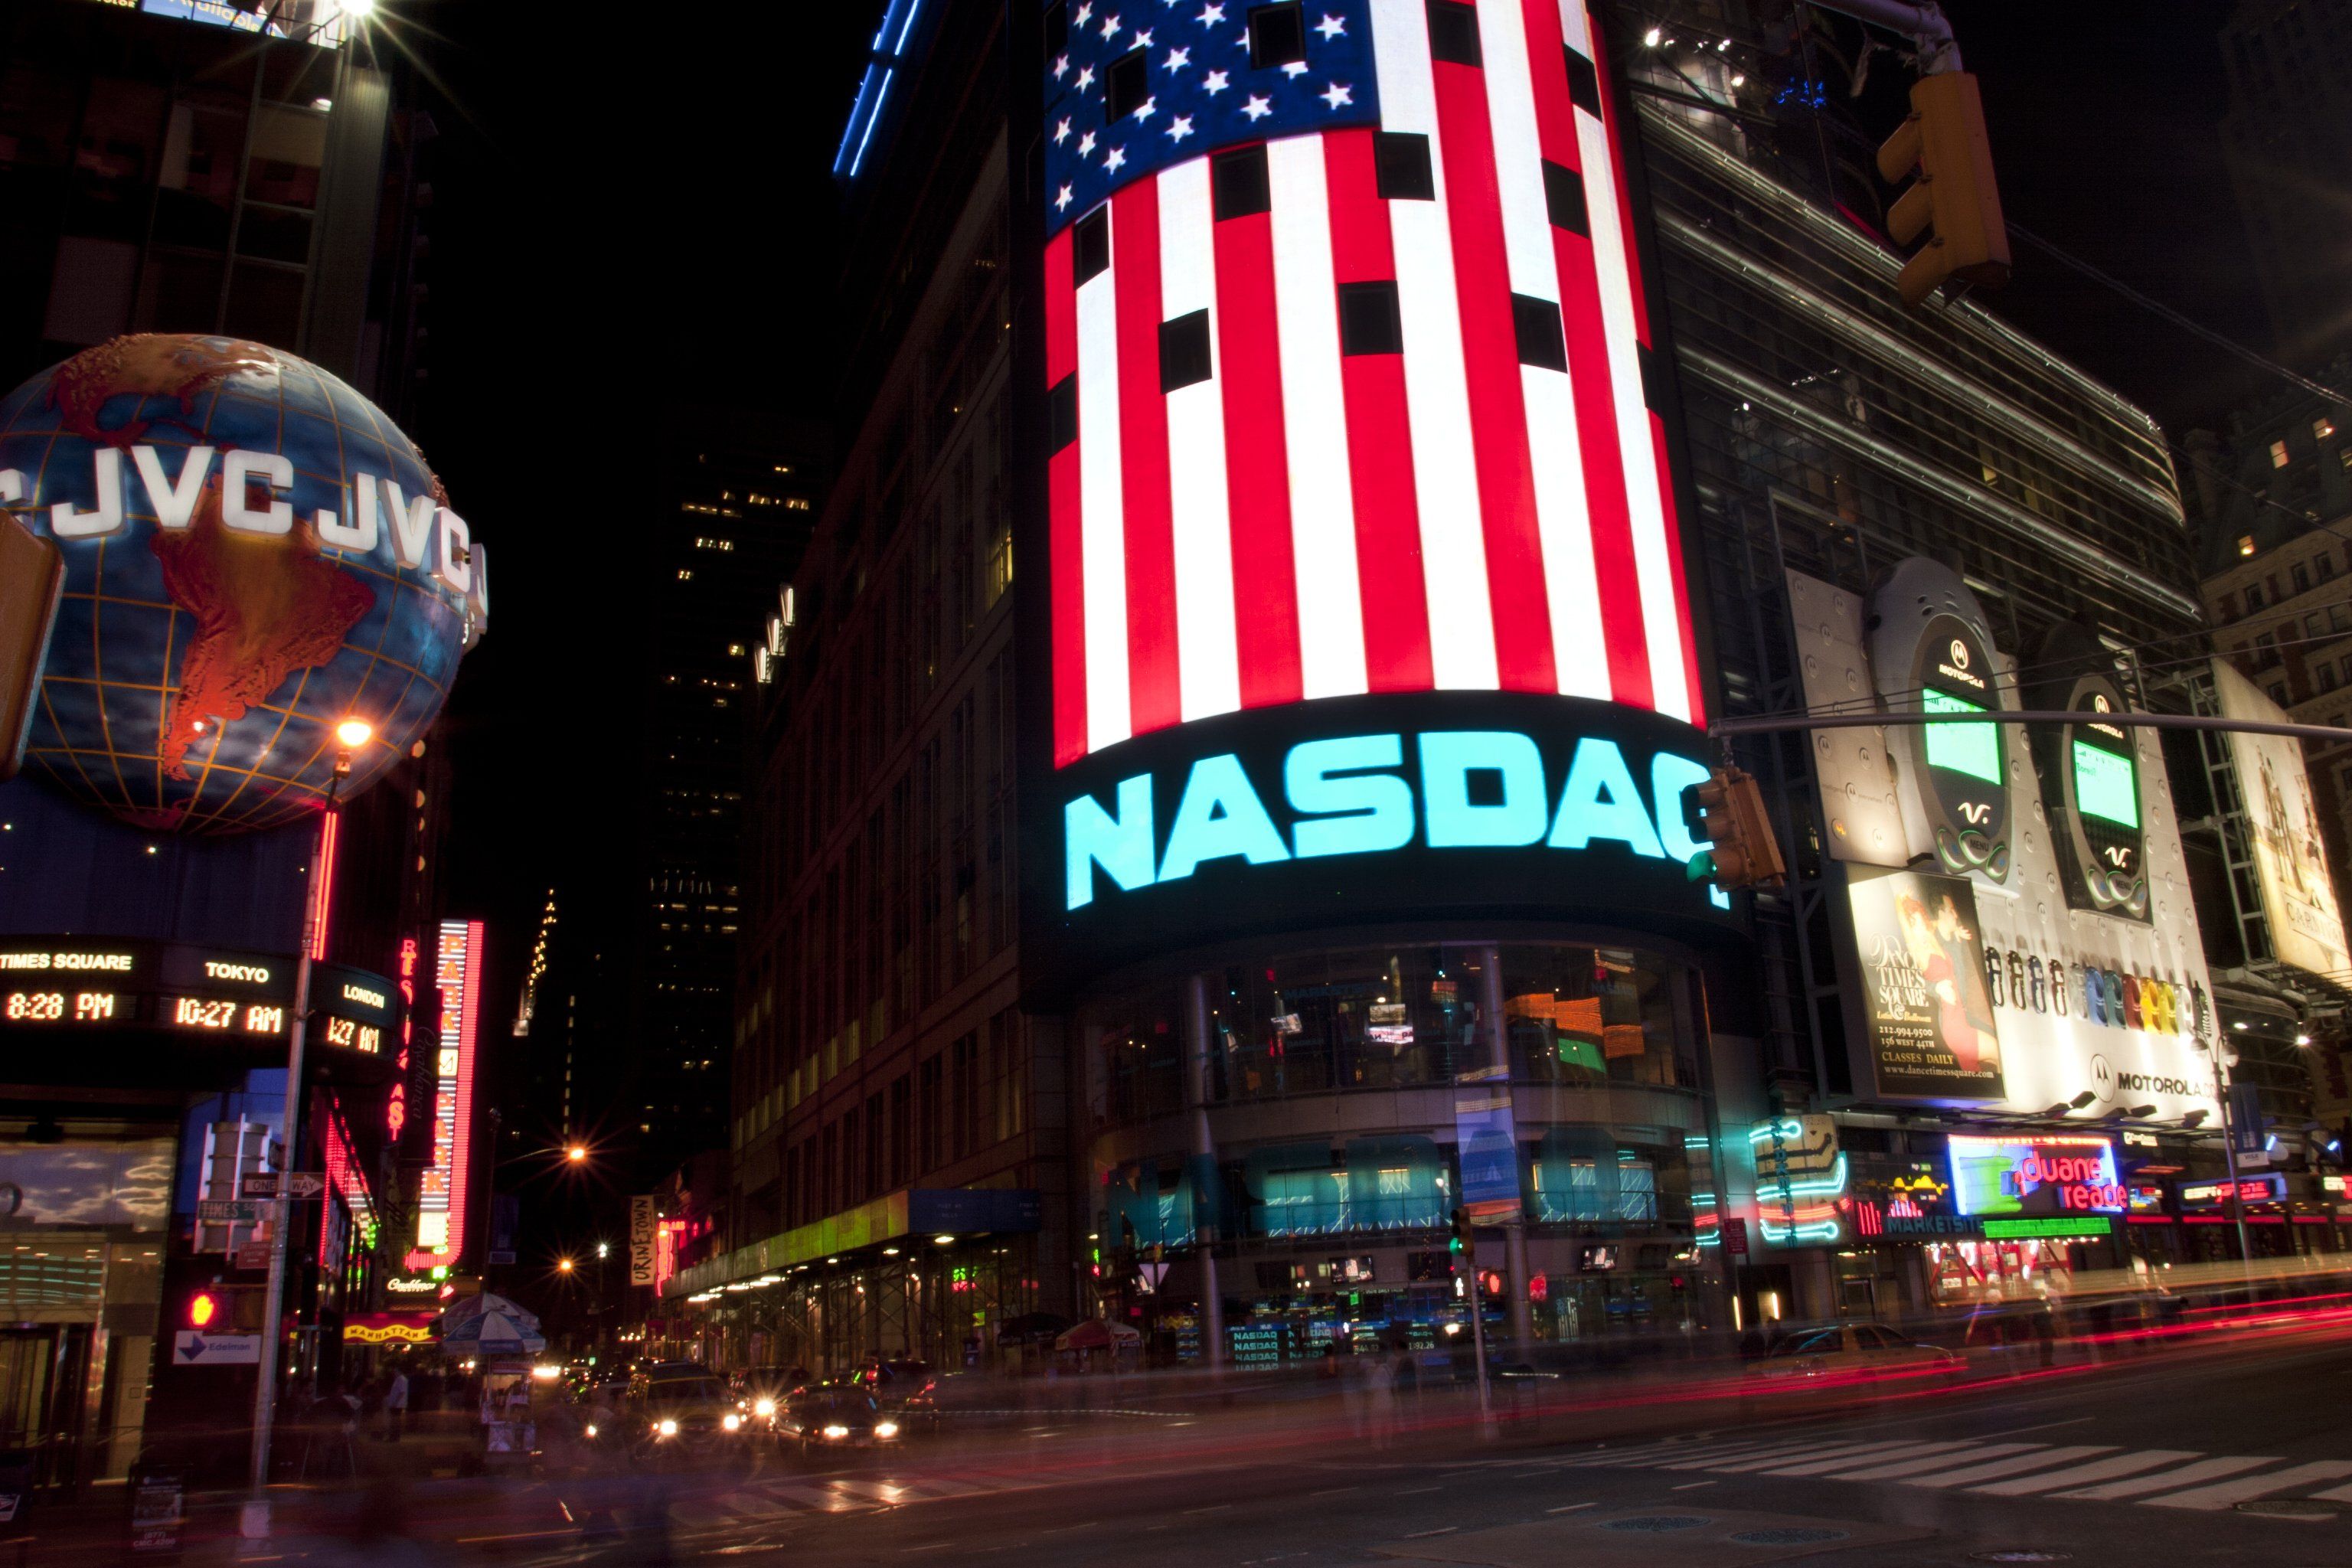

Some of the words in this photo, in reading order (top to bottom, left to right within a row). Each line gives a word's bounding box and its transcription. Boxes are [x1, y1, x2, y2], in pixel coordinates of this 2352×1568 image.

[51, 446, 294, 537] JVC
[312, 472, 470, 594] JVC
[1939, 664, 1984, 689] MOTOROLA
[1969, 838, 1989, 852] MENU
[2115, 879, 2132, 891] MENU
[0, 954, 50, 970] TIMES
[54, 954, 132, 971] SQUARE
[205, 962, 269, 983] TOKYO
[1877, 966, 1926, 988] TIMES
[439, 935, 464, 1031] PARK
[343, 985, 384, 1009] LONDON
[1879, 985, 1929, 1008] SQUARE
[7, 994, 64, 1020] 8:28
[77, 994, 114, 1021] PM
[175, 998, 236, 1027] 10:27
[247, 1006, 283, 1033] AM
[358, 1026, 380, 1054] AM
[1881, 1037, 1894, 1048] 156
[1896, 1038, 1915, 1047] WEST
[1916, 1040, 1935, 1050] 44TH
[1882, 1051, 1922, 1063] CLASSES
[1926, 1054, 1953, 1064] DAILY
[1883, 1064, 1995, 1079] www.dancetimessquare.com
[424, 1093, 454, 1193] PARK
[2022, 1150, 2102, 1183] duane
[253, 1180, 276, 1191] ONE
[292, 1180, 315, 1191] WAY
[2063, 1184, 2128, 1210] reade
[201, 1203, 239, 1219] TIMES
[387, 1278, 436, 1291] Casablanca
[350, 1328, 419, 1339] MANHATTAN
[1233, 1331, 1278, 1341] NASDAQ
[208, 1343, 251, 1351] Edelman
[1234, 1341, 1278, 1351] NASDAQ
[1235, 1352, 1279, 1361] NASDAQ
